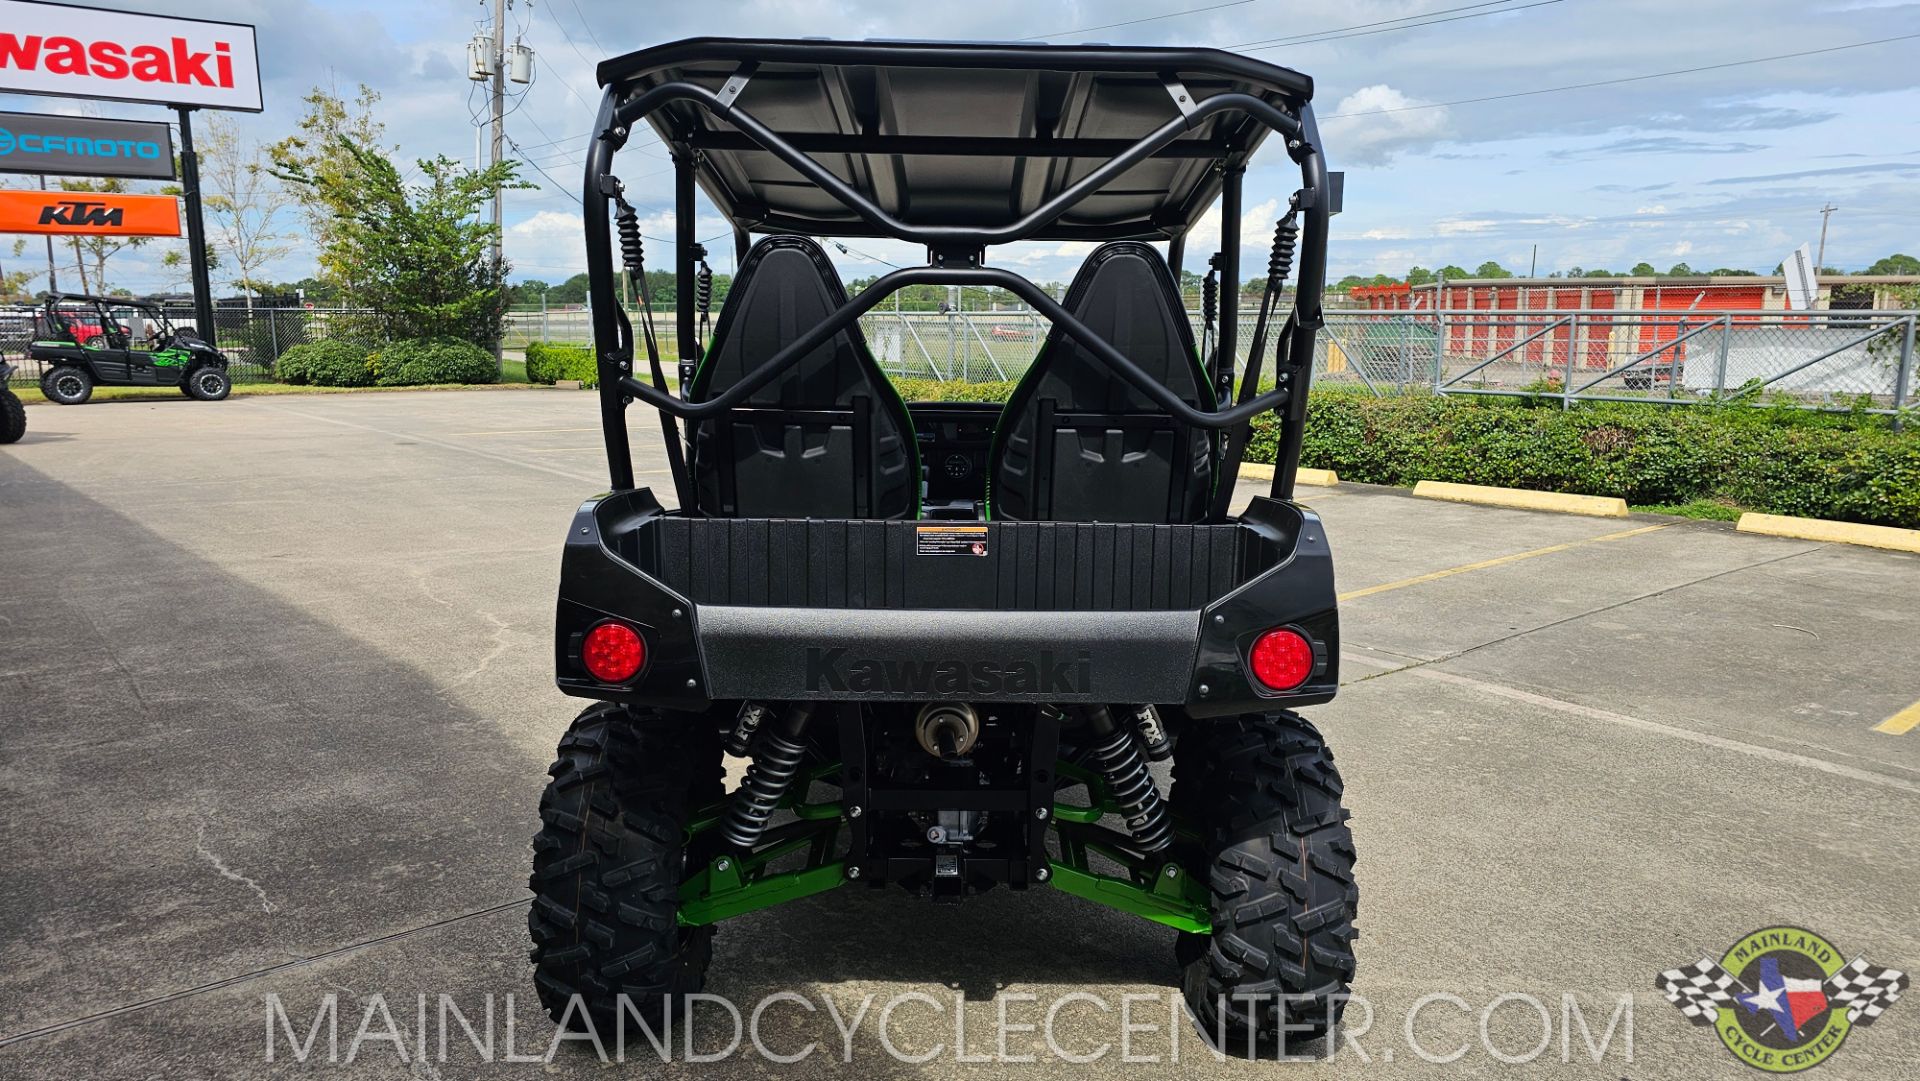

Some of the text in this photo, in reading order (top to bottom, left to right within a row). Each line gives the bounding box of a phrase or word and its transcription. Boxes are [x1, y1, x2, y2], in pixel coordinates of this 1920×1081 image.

[18, 133, 160, 160] CFMOTO
[38, 201, 124, 227] KTM
[805, 647, 1092, 694] Kawasaki
[1136, 708, 1163, 745] FOX
